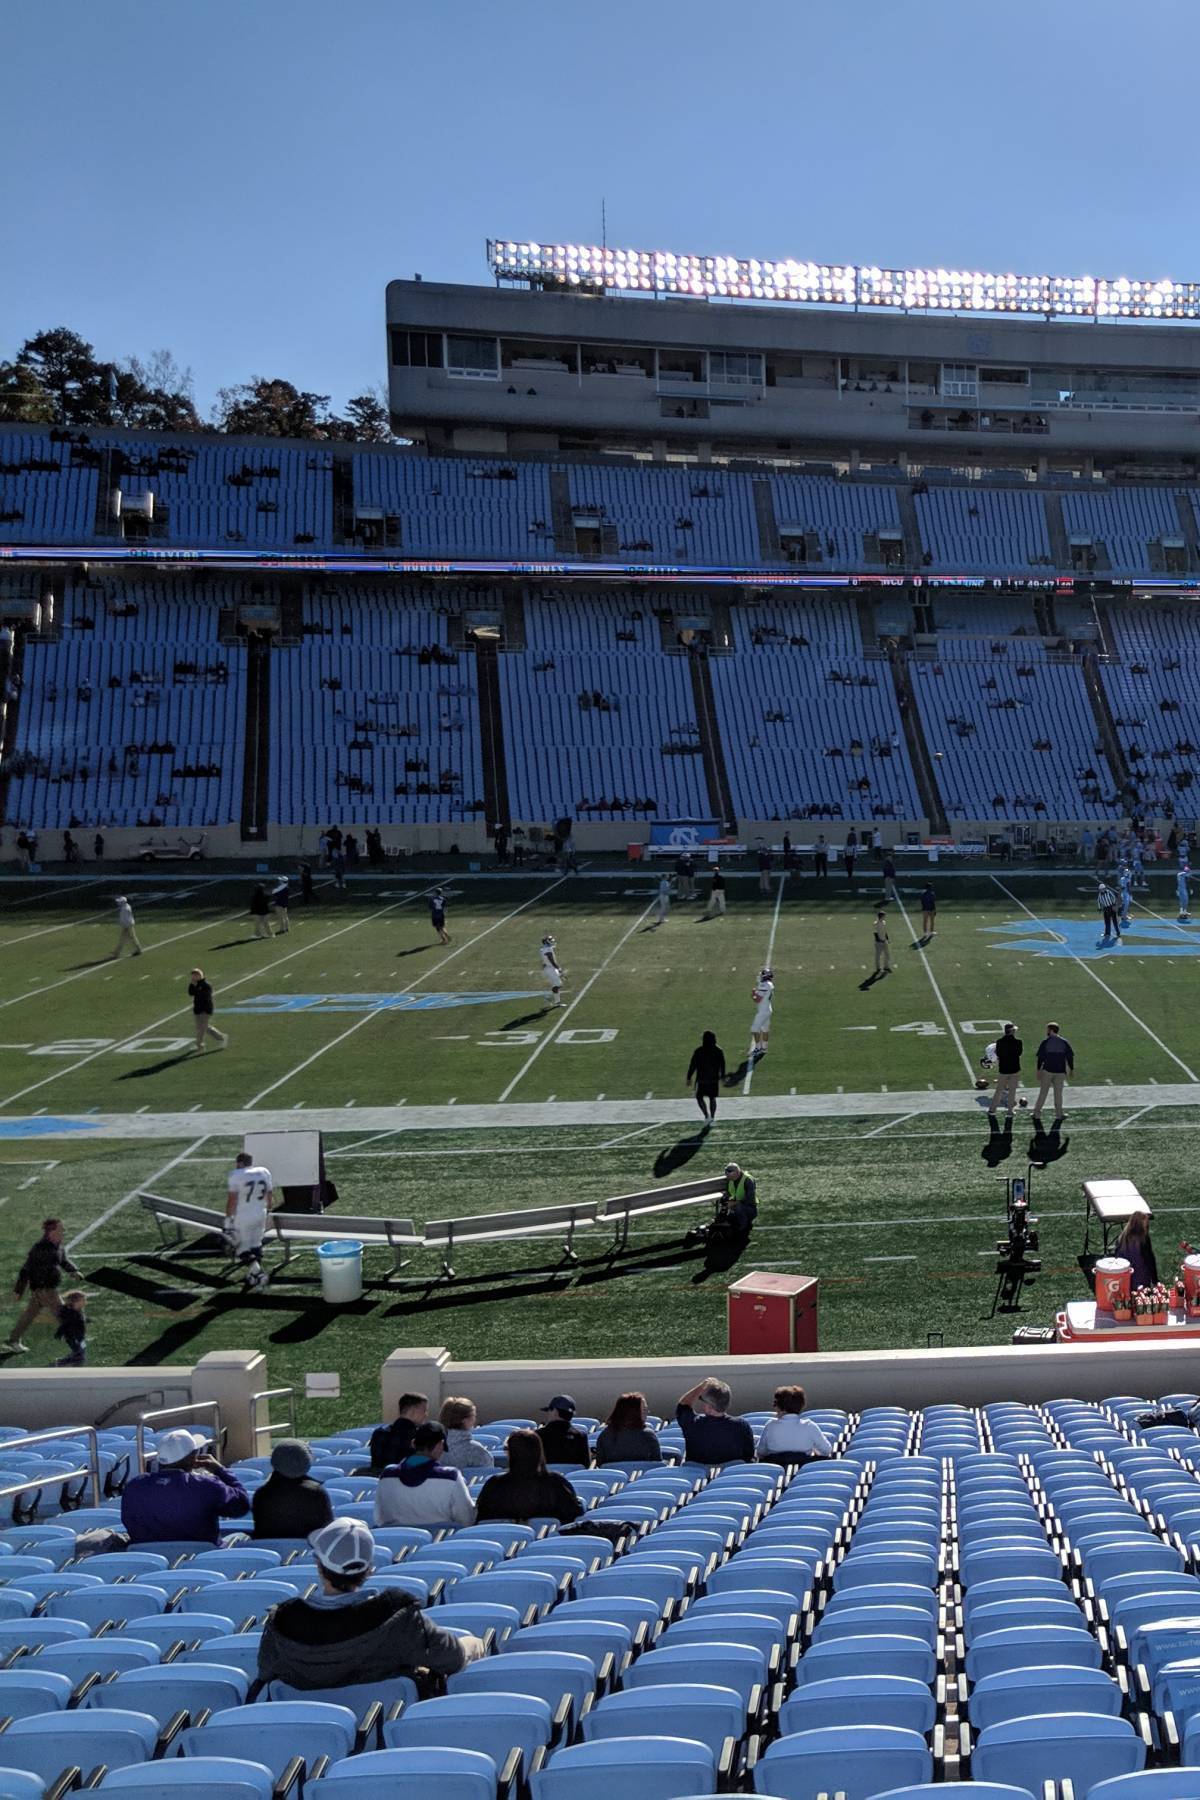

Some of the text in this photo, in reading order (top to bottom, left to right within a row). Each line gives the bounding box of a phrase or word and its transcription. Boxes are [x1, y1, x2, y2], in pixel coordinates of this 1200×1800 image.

[888, 1019, 1014, 1036] 40
[26, 1037, 198, 1056] 20
[476, 1028, 620, 1047] 30
[244, 1180, 267, 1203] 73
[1108, 1280, 1120, 1292] G
